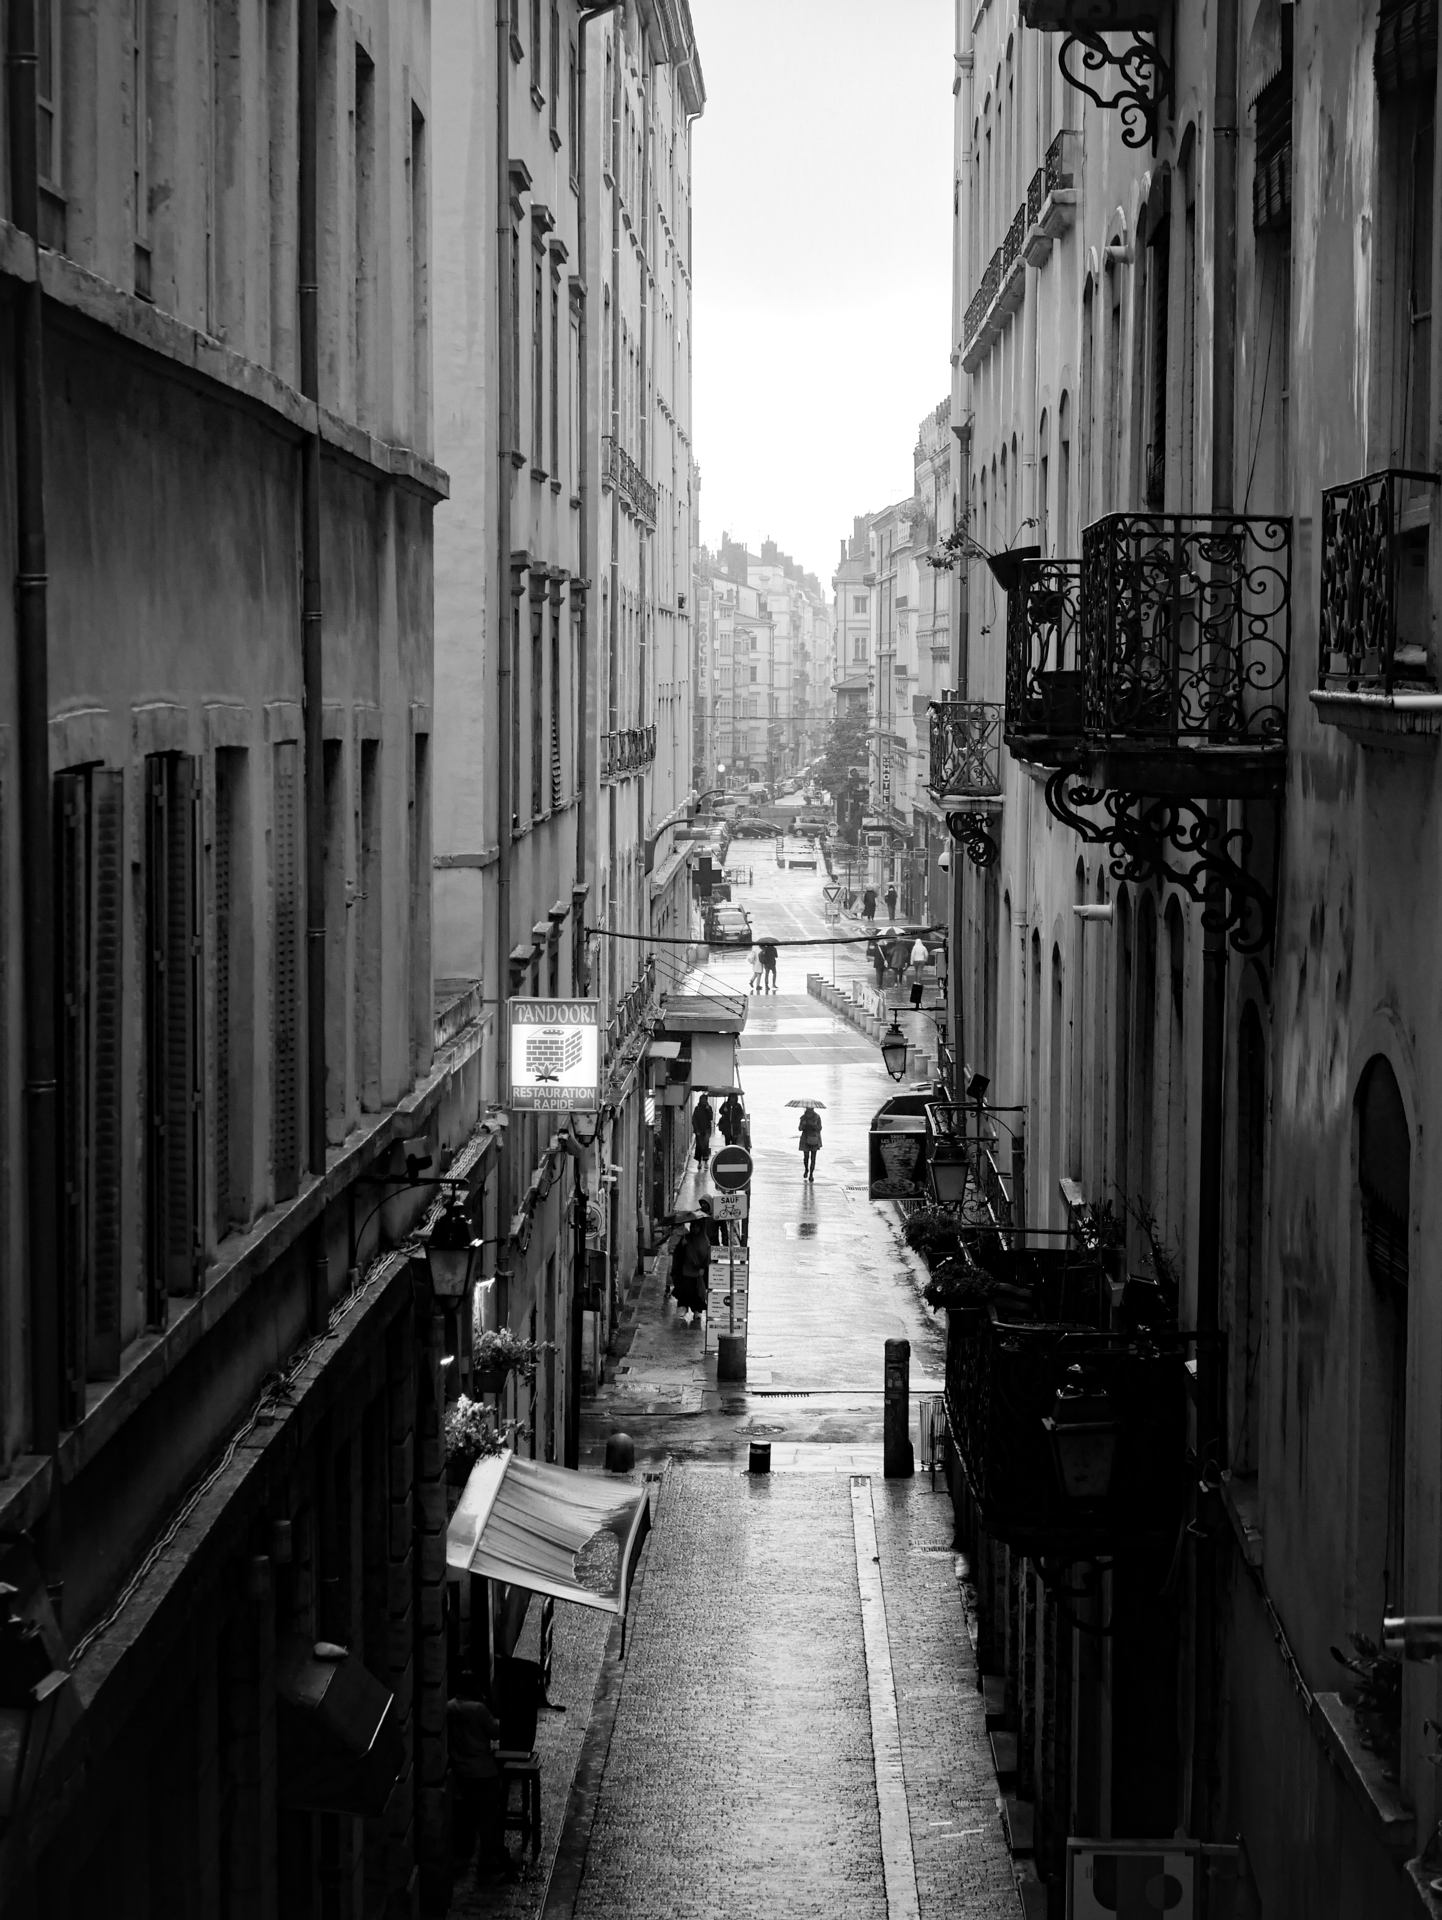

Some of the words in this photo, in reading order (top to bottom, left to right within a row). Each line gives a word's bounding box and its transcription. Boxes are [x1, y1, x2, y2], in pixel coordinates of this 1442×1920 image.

[700, 622, 708, 678] ROCHE
[515, 1004, 596, 1023] TANDOORI
[513, 1087, 595, 1099] RESTAURATION
[534, 1099, 574, 1109] RAPIDE
